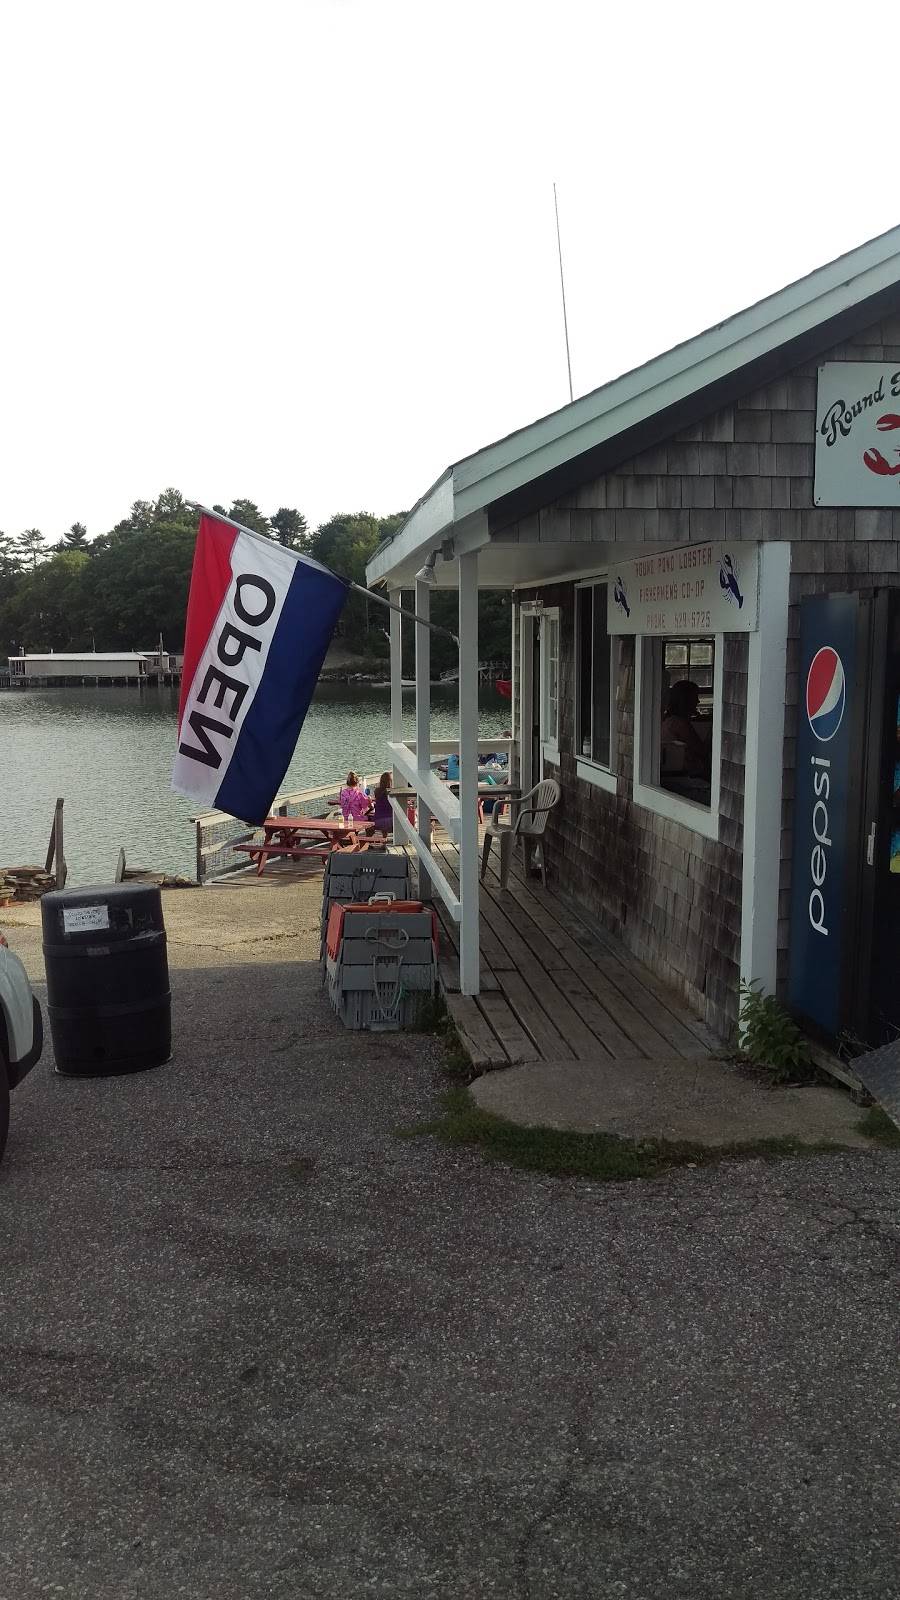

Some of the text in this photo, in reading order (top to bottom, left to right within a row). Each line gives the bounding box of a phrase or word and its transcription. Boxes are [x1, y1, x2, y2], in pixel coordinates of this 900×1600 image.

[821, 376, 885, 447] Round
[680, 548, 713, 570] LOBSTER
[681, 579, 705, 599] CO-OP
[809, 755, 833, 936] pepsi
